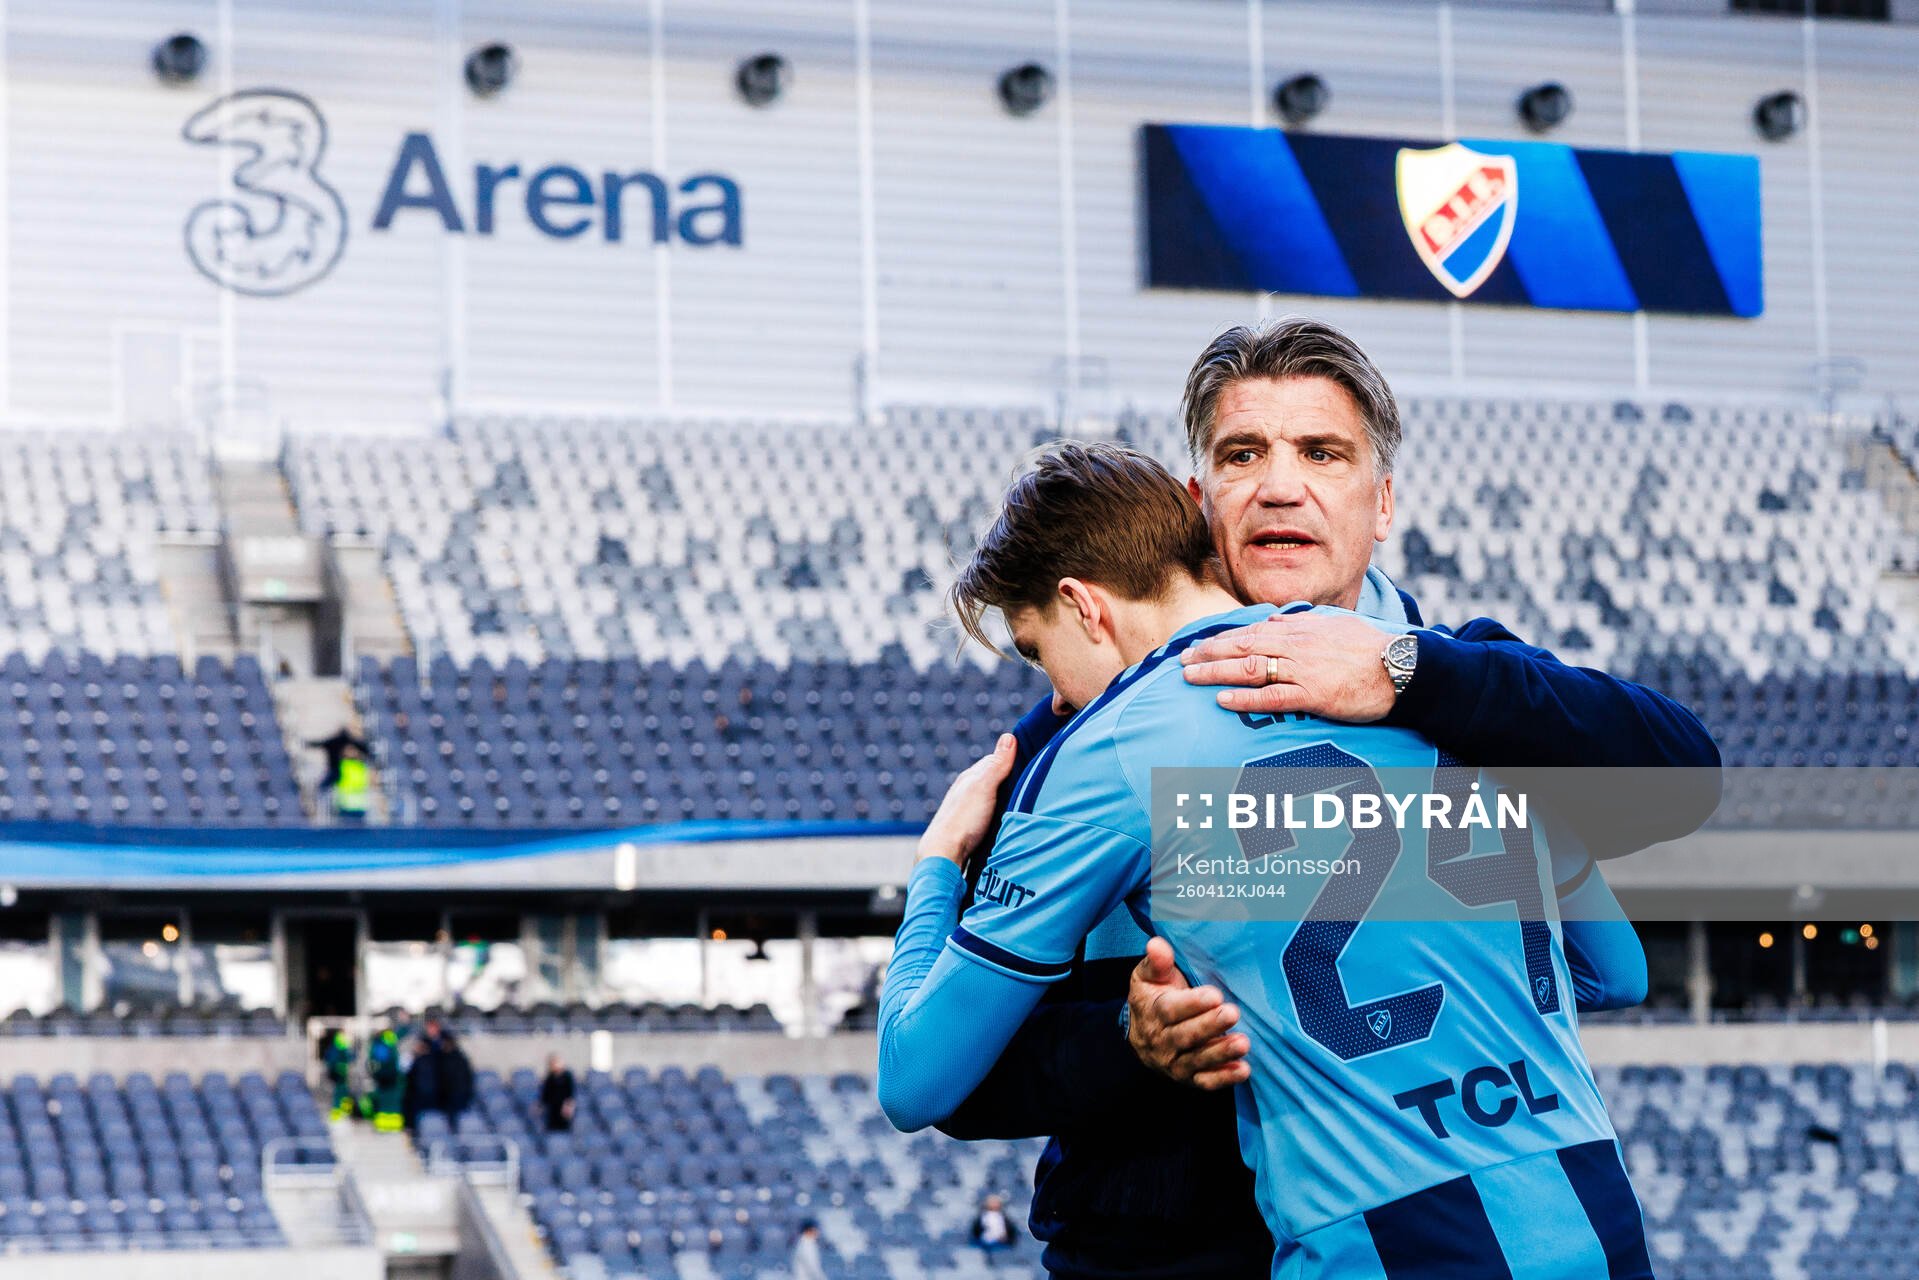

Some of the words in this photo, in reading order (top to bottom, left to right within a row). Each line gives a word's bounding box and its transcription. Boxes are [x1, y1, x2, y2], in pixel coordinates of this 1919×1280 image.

[182, 87, 349, 297] 3
[371, 132, 743, 247] Arena
[1231, 740, 1560, 1063] 24
[1393, 1059, 1560, 1139] TCL
